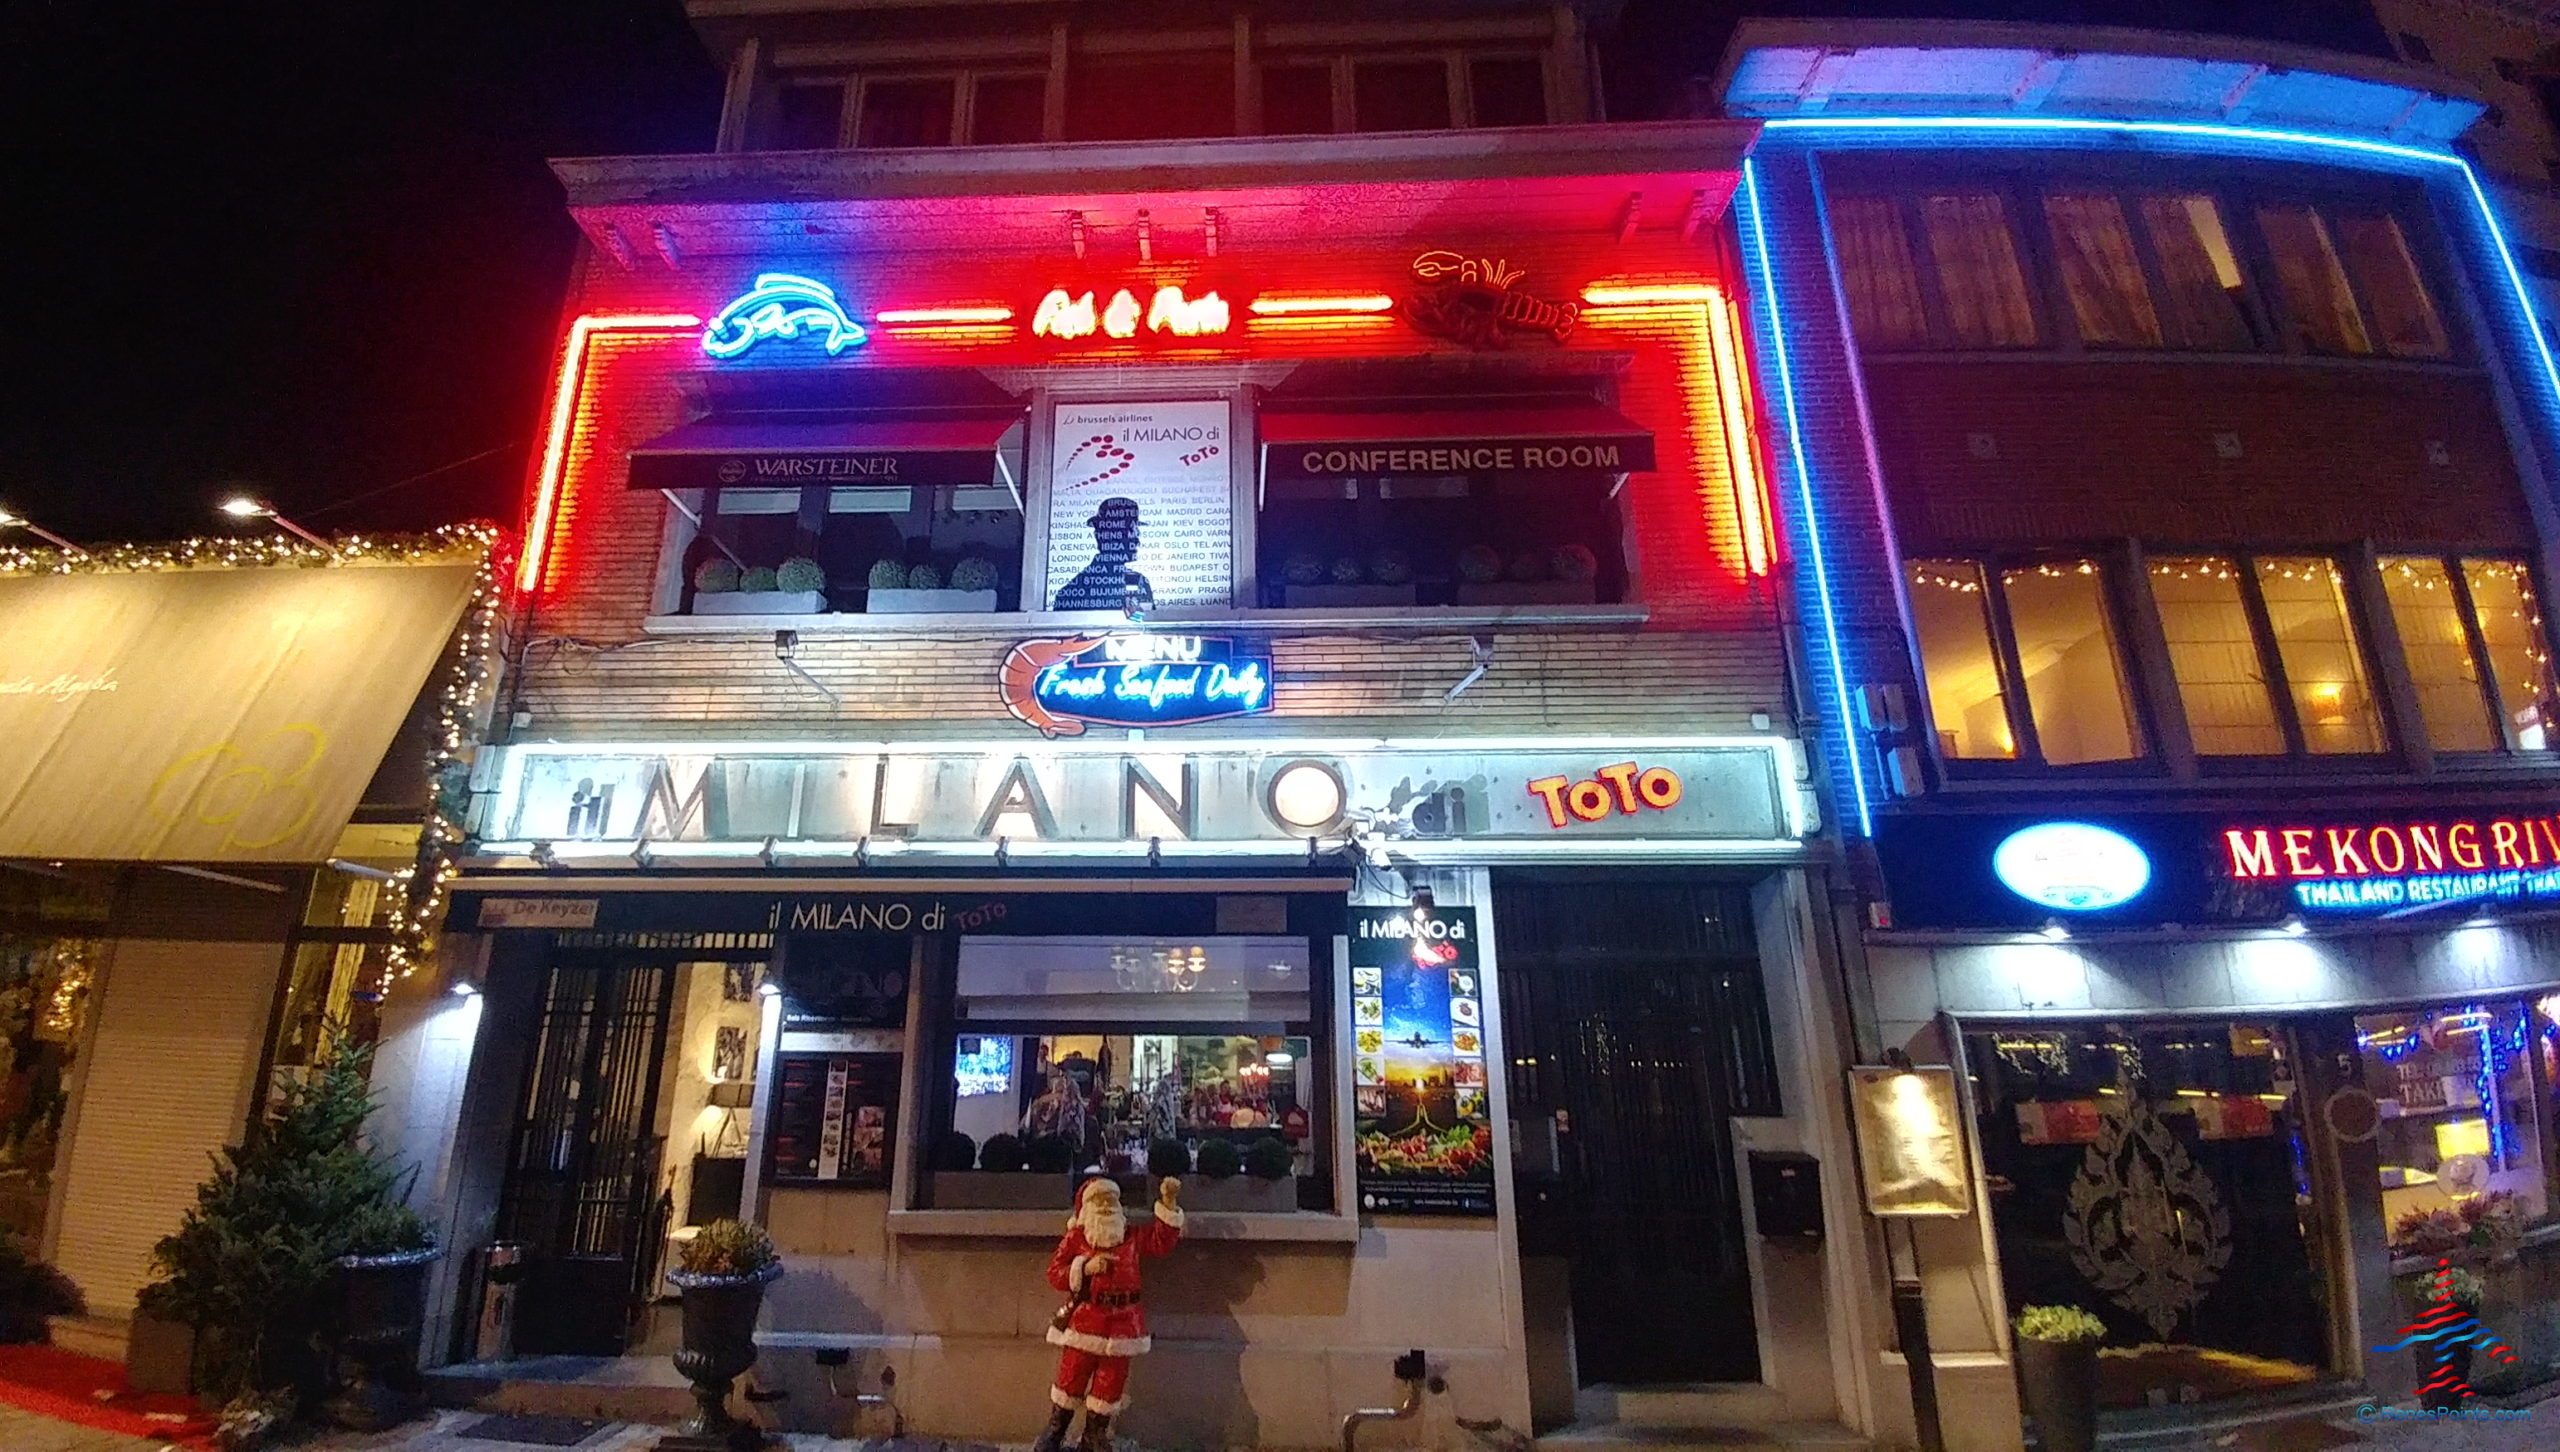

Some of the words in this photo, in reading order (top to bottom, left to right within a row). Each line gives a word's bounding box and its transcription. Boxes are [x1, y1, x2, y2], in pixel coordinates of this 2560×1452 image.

[1077, 415, 1116, 424] brussels
[1118, 414, 1153, 423] airlines
[1123, 429, 1130, 442] il
[1134, 427, 1203, 442] MILANO
[1207, 426, 1220, 440] di
[1303, 447, 1514, 473] CONFERENCE
[1523, 445, 1621, 469] ROOM
[755, 457, 898, 477] WARSTEINER
[1161, 497, 1187, 505] PARIS
[1105, 509, 1162, 518] AMSTERDAM
[1167, 508, 1203, 516] MADRID
[1099, 520, 1126, 529] ROME
[1173, 519, 1194, 527] KIEV
[1174, 530, 1203, 538] CAIRO
[1060, 543, 1097, 551] GENEVA
[1101, 542, 1125, 551] IBIZA
[1164, 541, 1190, 549] OSLO
[1194, 541, 1210, 549] TEL
[1052, 554, 1090, 562] LONDON
[1095, 553, 1129, 562] VIENNA
[1168, 552, 1206, 560] JANEIRO
[1170, 563, 1218, 571] BUDAPEST
[1049, 588, 1086, 597] MEXICO
[1106, 635, 1201, 661] MENU
[1039, 662, 1106, 698] Fresh
[1114, 663, 1202, 711] Seafood
[1206, 662, 1266, 710] Daily
[2296, 879, 2404, 907] THAILAND
[769, 901, 782, 929] il
[790, 903, 912, 931] MILANO
[921, 902, 946, 930] di
[1359, 918, 1369, 939] il
[1371, 919, 1447, 939] MILANO
[1450, 918, 1466, 939] di
